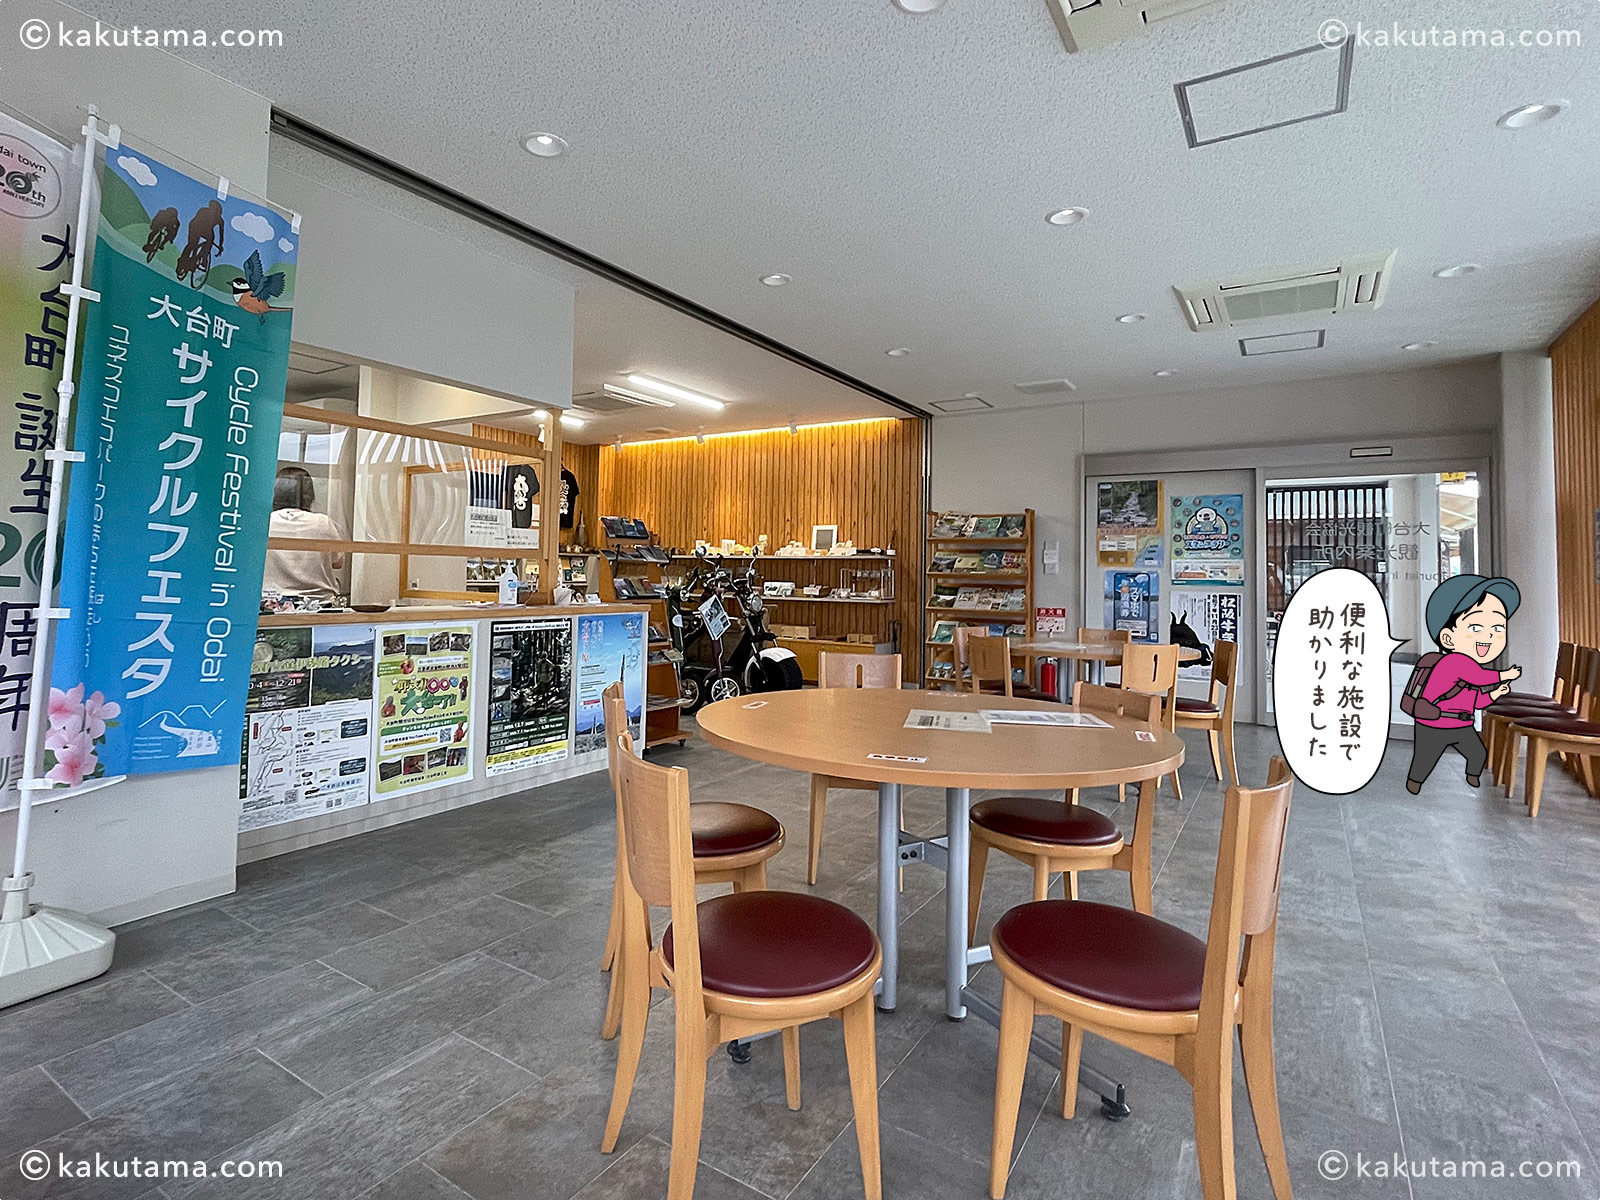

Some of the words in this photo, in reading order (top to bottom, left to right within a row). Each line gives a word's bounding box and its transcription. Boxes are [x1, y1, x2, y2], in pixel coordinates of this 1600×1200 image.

[17, 154, 47, 173] town
[147, 294, 240, 349] 大台町
[227, 366, 259, 445] Cycle
[122, 342, 213, 700] サイクルフェスタ
[213, 453, 250, 572] Festival
[209, 582, 236, 607] in
[200, 617, 232, 682] Odai
